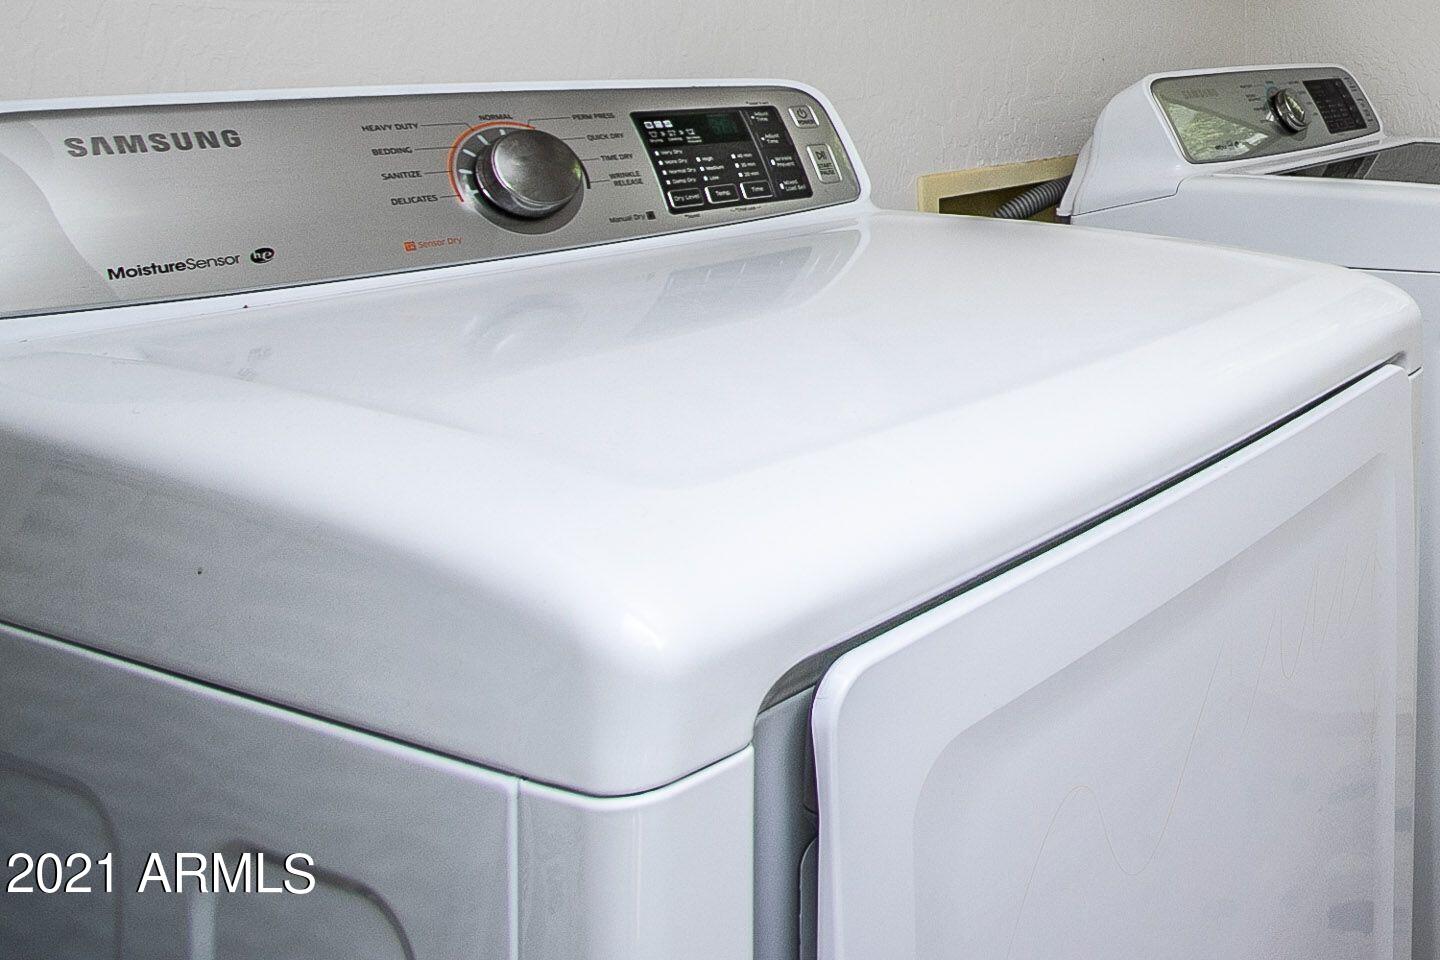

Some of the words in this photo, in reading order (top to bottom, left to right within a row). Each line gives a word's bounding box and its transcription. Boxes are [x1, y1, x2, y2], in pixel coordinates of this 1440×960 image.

[478, 113, 513, 121] NORMAL
[361, 124, 392, 132] HEAVY
[64, 128, 242, 159] SAMSUNG
[371, 147, 413, 156] BEDDING
[381, 171, 422, 180] SANITIZE
[609, 171, 641, 179] WRINKLE
[613, 178, 643, 186] RELEASE
[390, 194, 438, 205] DELICATES
[447, 237, 462, 245] Dry
[107, 255, 241, 280] MoistureSensor
